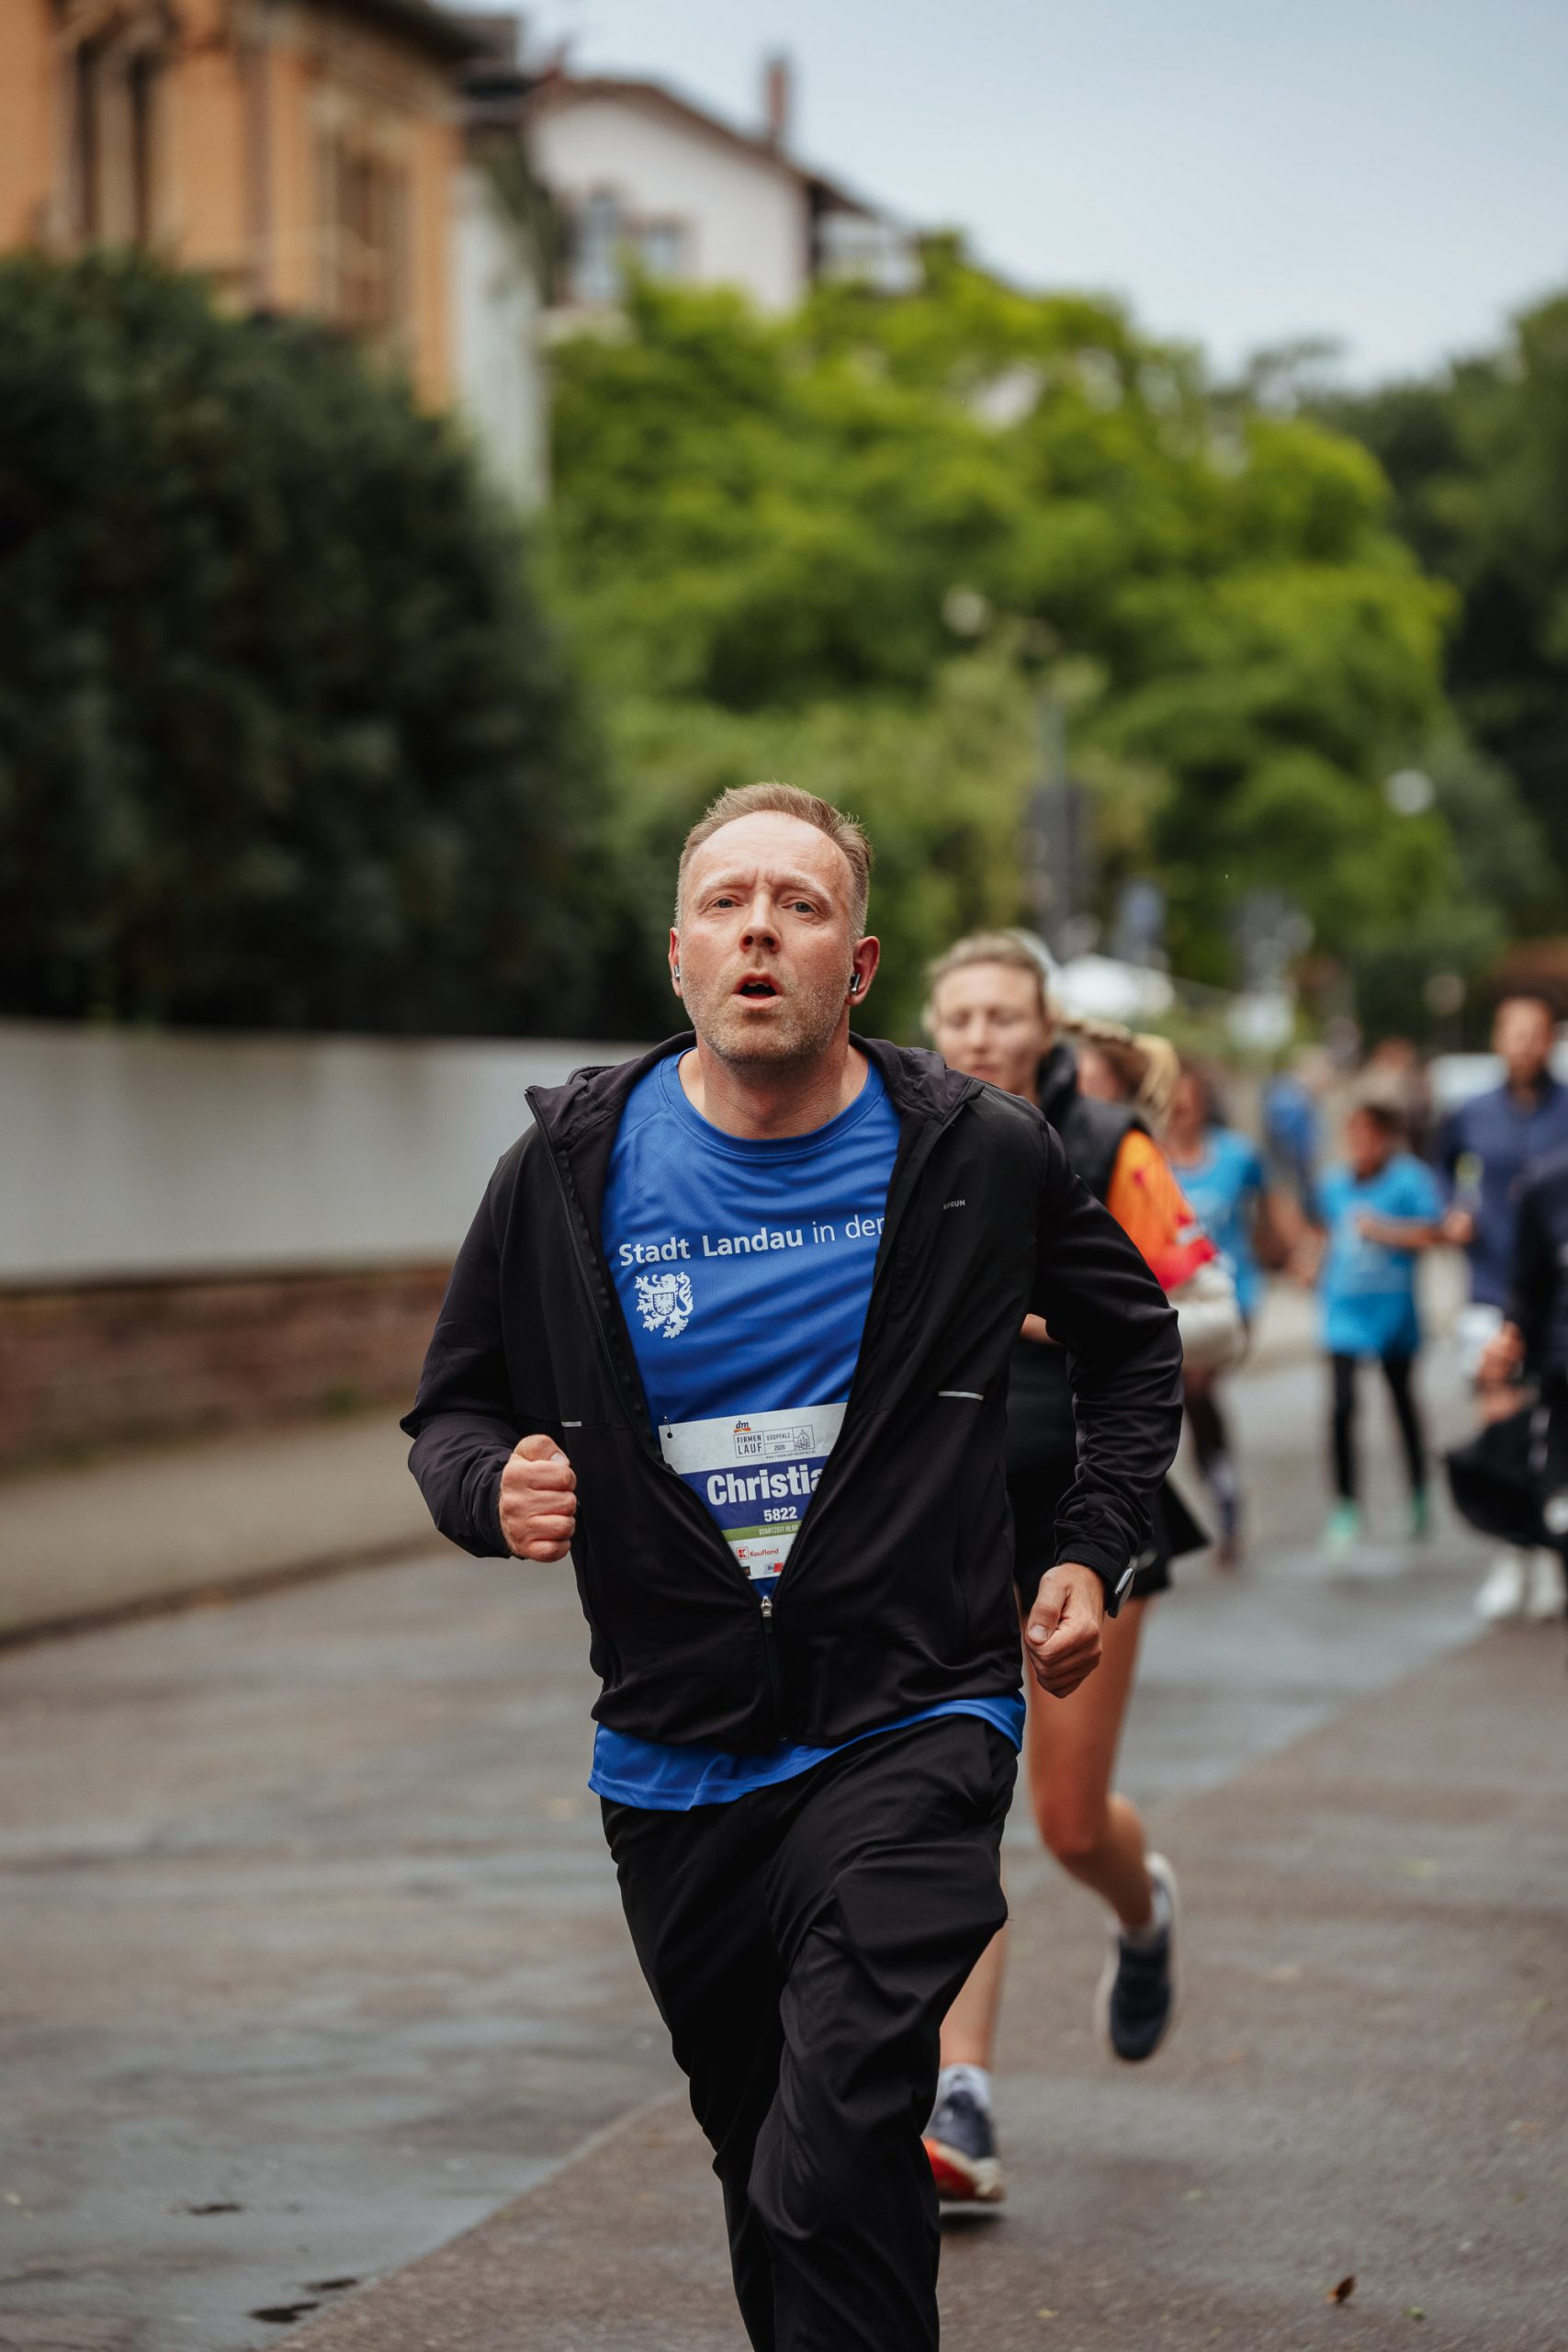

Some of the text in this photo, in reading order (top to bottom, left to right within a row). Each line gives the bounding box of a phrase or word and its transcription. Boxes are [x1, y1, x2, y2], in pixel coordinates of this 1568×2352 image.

[618, 1214, 885, 1266] Stadt Landau in der
[735, 1419, 750, 1429] dm
[737, 1434, 761, 1444] FIRMEN
[738, 1443, 763, 1455] LAUF
[763, 1506, 797, 1522] 5822
[750, 1547, 779, 1557] Kaufland
